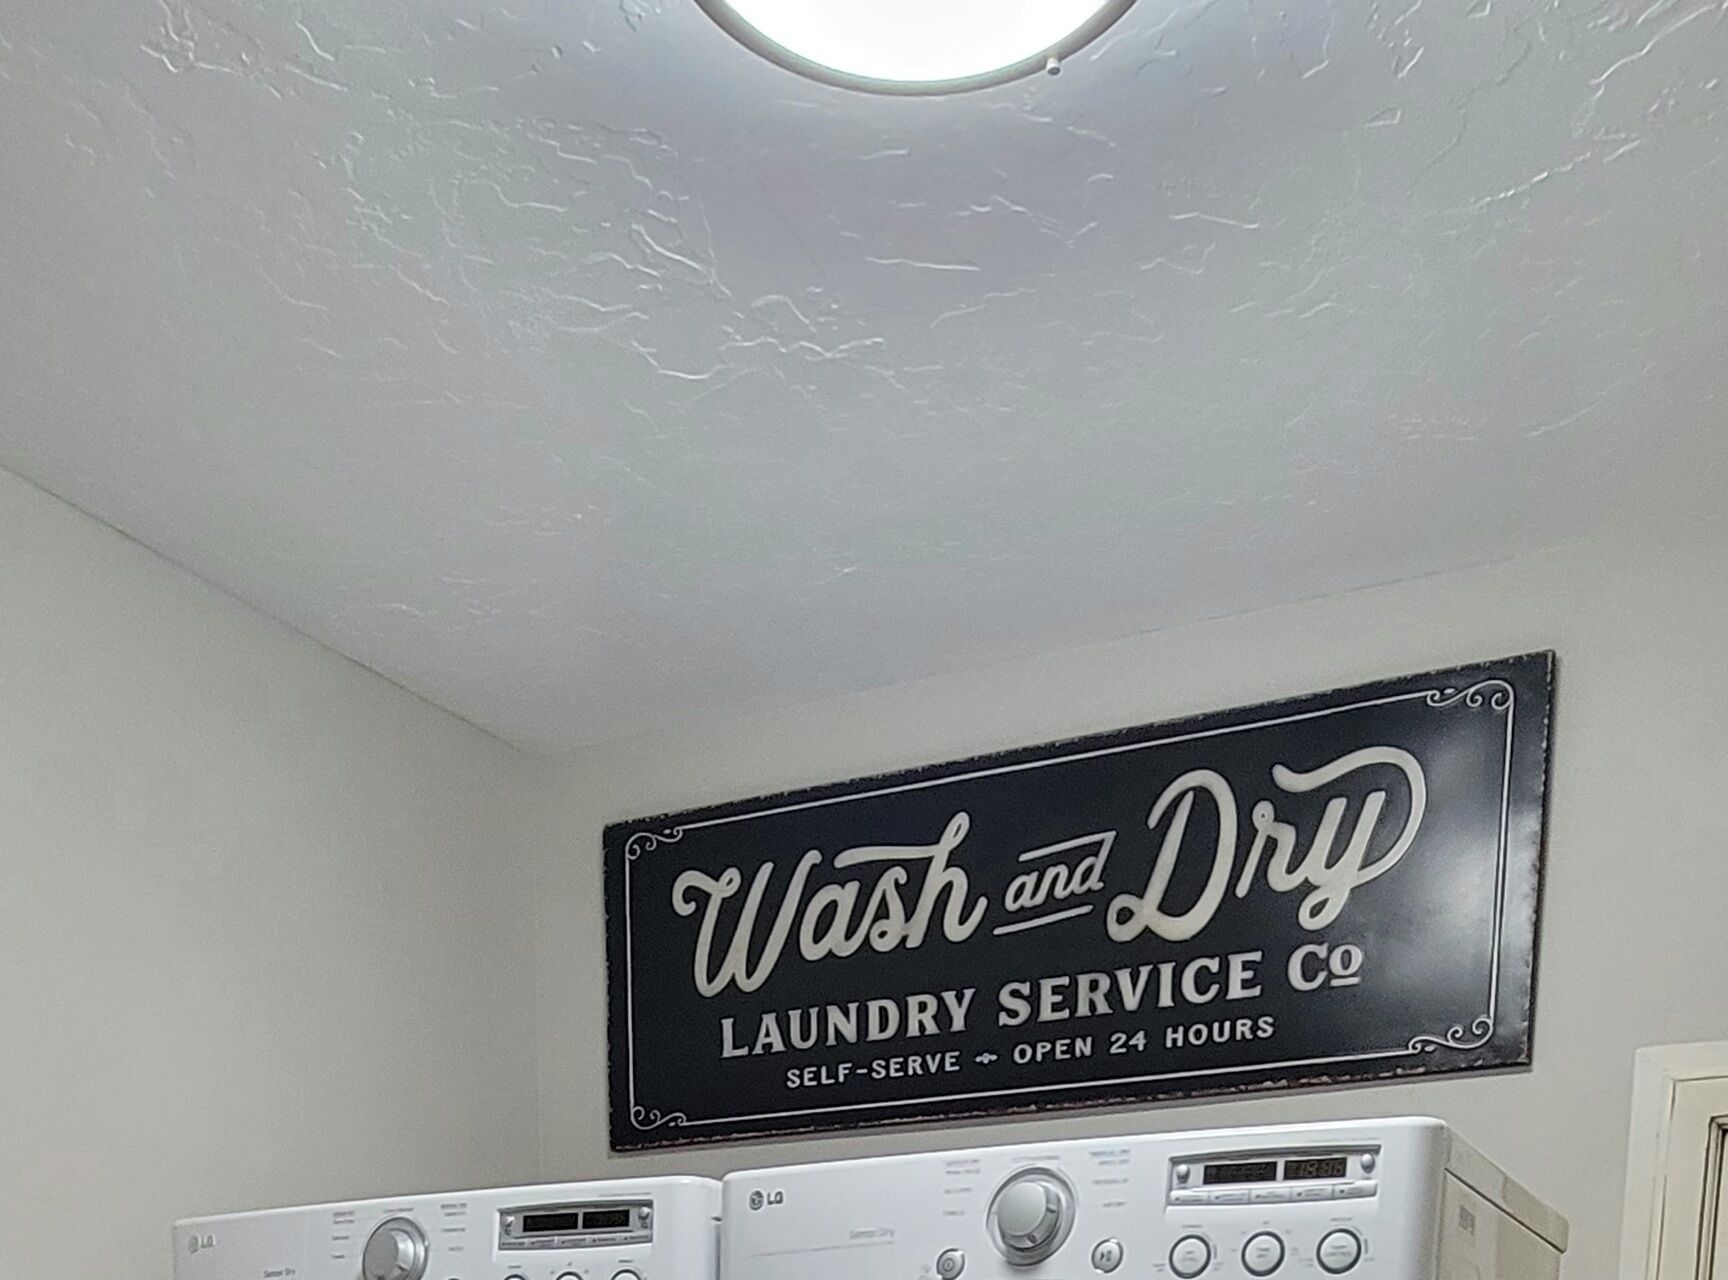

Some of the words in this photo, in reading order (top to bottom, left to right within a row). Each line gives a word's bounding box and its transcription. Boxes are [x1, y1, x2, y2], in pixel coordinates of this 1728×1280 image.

[672, 811, 988, 997] Wash
[1003, 829, 1117, 913] and
[1105, 745, 1427, 942] Dry
[721, 987, 976, 1059] LAUNDRY
[998, 950, 1263, 1027] SERVICE
[1287, 942, 1363, 991] Co
[786, 1052, 961, 1088] SELF-SERVE
[1013, 1036, 1093, 1064] OPEN
[1109, 1030, 1147, 1054] 24
[1165, 1016, 1275, 1048] HOURS
